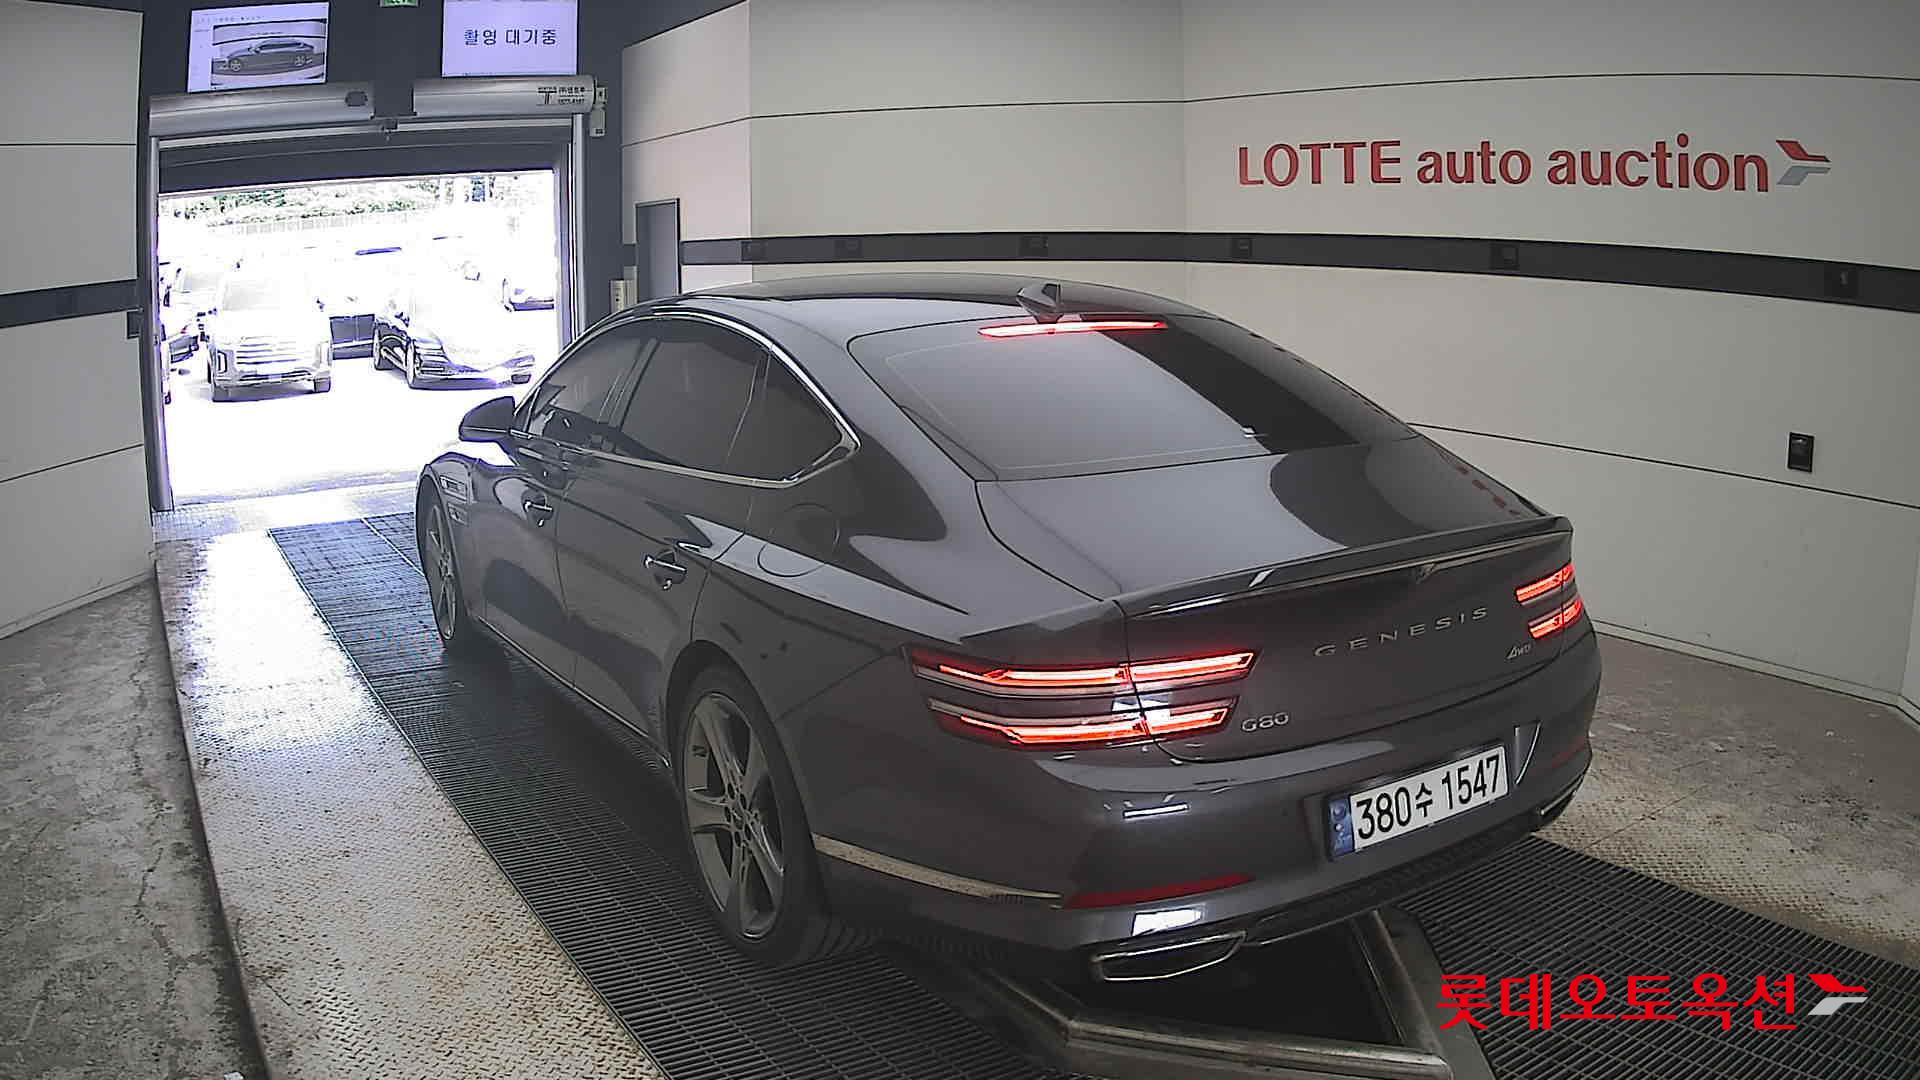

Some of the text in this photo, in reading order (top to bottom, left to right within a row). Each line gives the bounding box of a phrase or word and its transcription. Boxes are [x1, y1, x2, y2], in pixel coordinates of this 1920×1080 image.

[505, 29, 557, 46] 대기중
[1238, 133, 1769, 192] LOTTE auto auction
[1314, 607, 1488, 657] GENESIS
[1242, 712, 1290, 732] G80
[1356, 754, 1500, 840] 380수 1547
